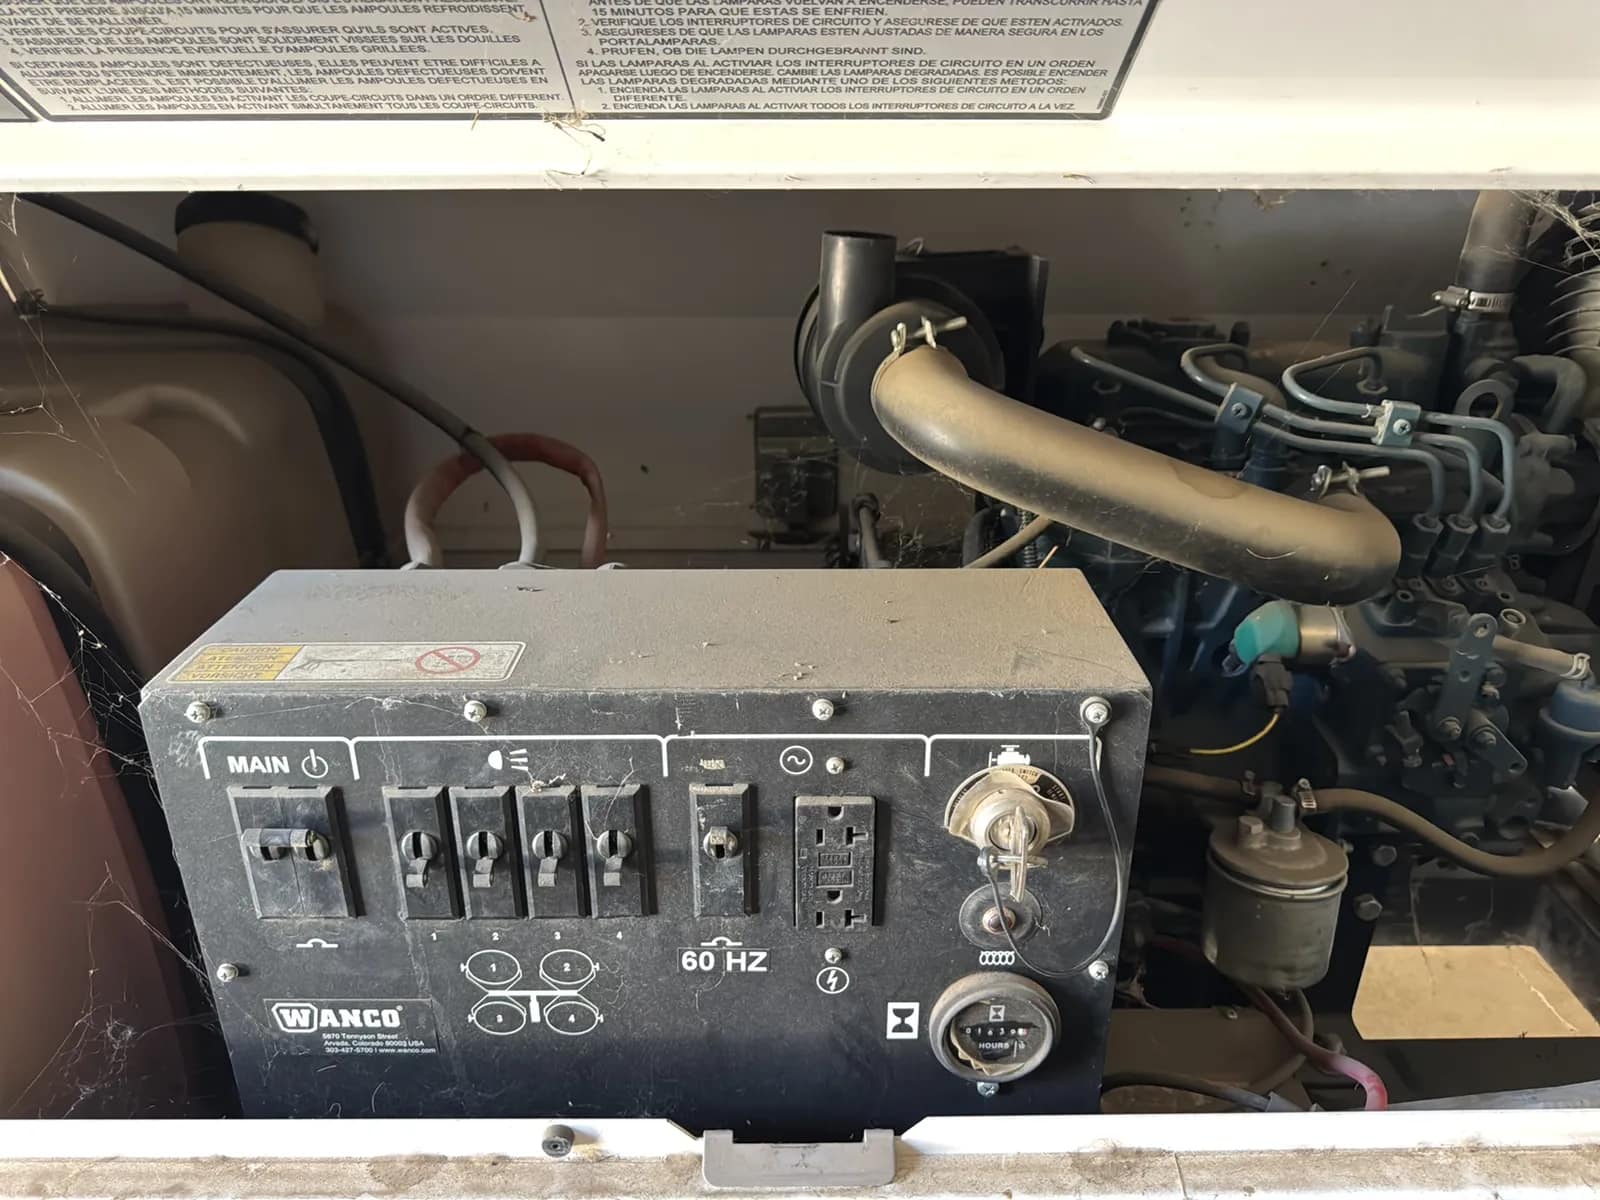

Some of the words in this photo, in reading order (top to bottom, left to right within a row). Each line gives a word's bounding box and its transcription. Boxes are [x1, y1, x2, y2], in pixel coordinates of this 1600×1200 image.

[609, 7, 674, 16] MINUTOS
[677, 7, 716, 16] PARA
[718, 7, 749, 16] QUE
[752, 7, 798, 16] ESTAS
[589, 17, 657, 26] VERIFIQUE
[658, 17, 684, 26] LOS
[686, 17, 789, 26] INTERRUPTORES
[811, 17, 871, 26] CIRCUITO
[883, 17, 960, 26] ASEGURESE
[980, 17, 1009, 26] QUE
[1009, 17, 1052, 26] ESTEN
[592, 27, 677, 36] ASEGURESES
[697, 27, 725, 36] QUE
[726, 27, 750, 36] LAS
[752, 27, 817, 36] LAMPARAS
[819, 27, 860, 36] ESTEN
[861, 27, 933, 36] AJUSTADAS
[953, 27, 1007, 36] MANERA
[1006, 27, 1059, 36] SEGURA
[1078, 27, 1105, 36] LOS
[684, 47, 707, 55] DIE
[709, 47, 764, 55] LAMPEN
[767, 46, 889, 55] DURCHGEBRANNT
[590, 59, 616, 67] LAS
[618, 59, 690, 67] LAMPARAS
[711, 59, 772, 67] ACTIVIAR
[775, 59, 801, 67] LOS
[804, 59, 915, 67] INTERRUPTORES
[938, 59, 1003, 67] CIRCUITO
[1047, 59, 1096, 67] ORDEN
[577, 68, 637, 76] APAGARSE
[638, 68, 678, 76] LUEGO
[776, 68, 818, 76] CAMBIE
[819, 68, 841, 76] LAS
[842, 68, 902, 76] LAMPARAS
[999, 68, 1047, 76] POSIBLE
[1047, 68, 1109, 76] ENCENDER
[580, 77, 606, 85] LAS
[607, 77, 677, 85] LAMPARAS
[679, 77, 768, 85] DEGRADADAS
[771, 77, 837, 85] MEDIANTE
[839, 77, 869, 85] UNO
[891, 77, 918, 85] LOS
[920, 77, 998, 85] SIGUIENTES
[227, 756, 290, 774] MAIN
[431, 932, 437, 941] 1
[492, 932, 499, 941] 2
[554, 932, 561, 941] 3
[616, 932, 623, 941] 4
[681, 951, 715, 972] 60
[726, 951, 768, 972] HZ
[490, 963, 497, 972] 1
[563, 963, 571, 972] 2
[273, 1004, 401, 1032] WANCO
[496, 1014, 503, 1023] 3
[568, 1014, 576, 1023] 4
